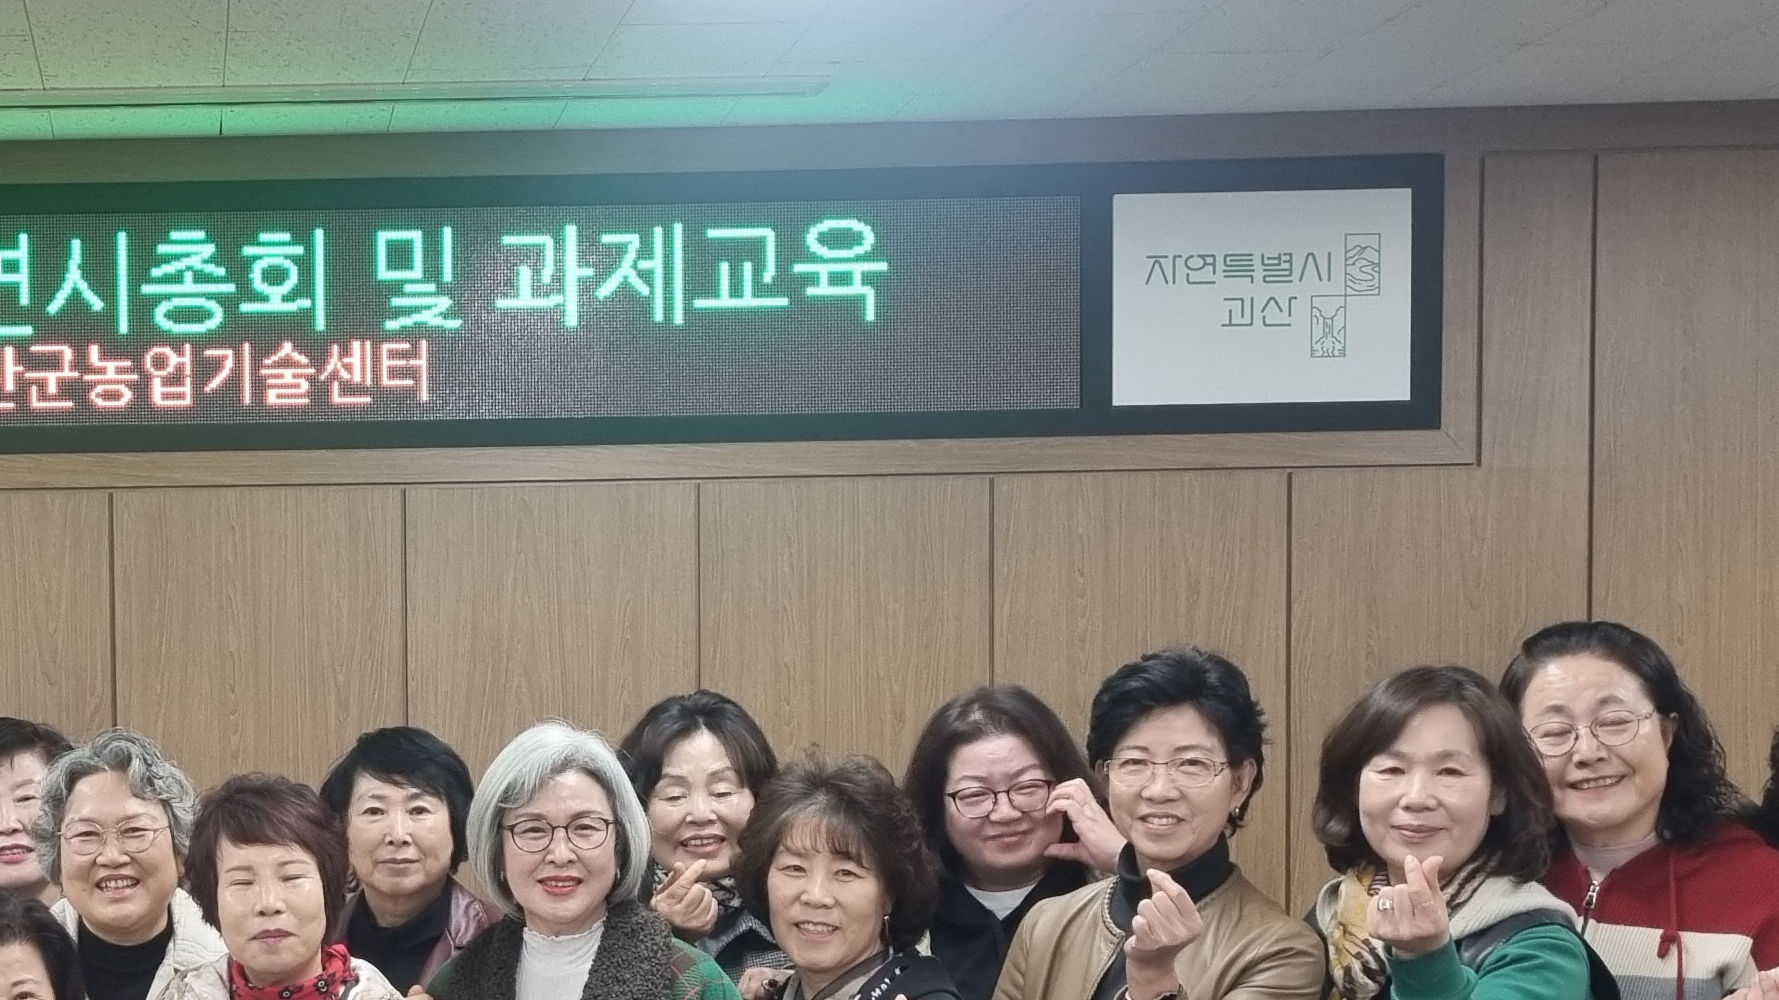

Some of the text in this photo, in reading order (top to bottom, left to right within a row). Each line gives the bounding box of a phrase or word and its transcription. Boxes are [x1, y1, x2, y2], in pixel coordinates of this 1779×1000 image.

[375, 225, 463, 330] 및
[495, 217, 889, 326] 과제교육
[1145, 250, 1332, 286] 자연특별시
[1221, 295, 1298, 328] 괴산
